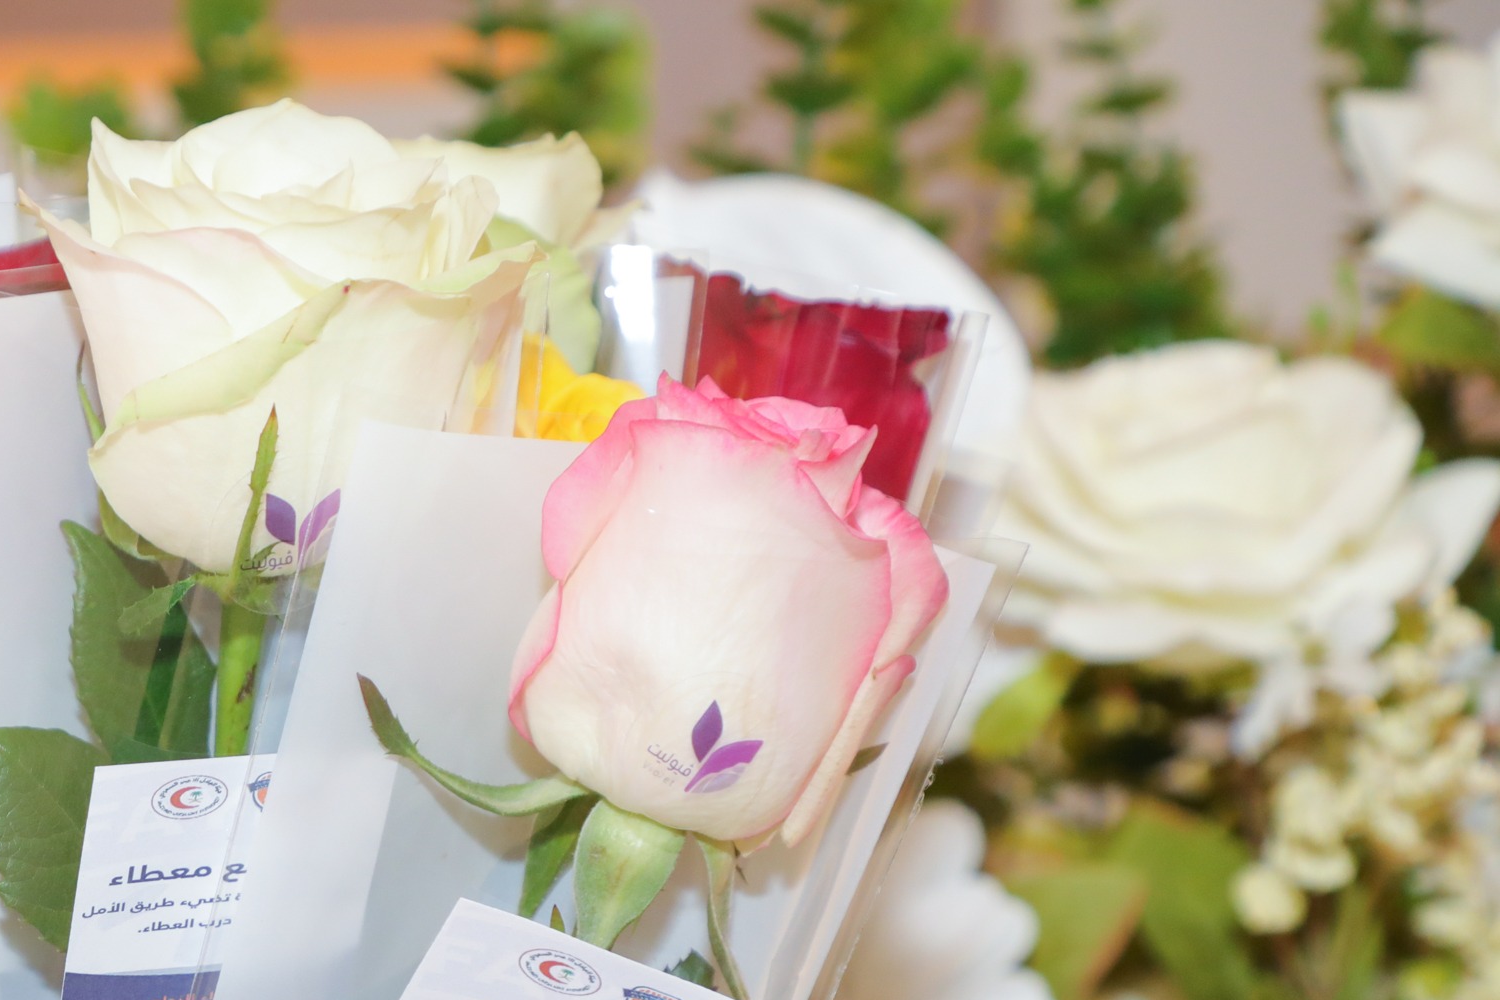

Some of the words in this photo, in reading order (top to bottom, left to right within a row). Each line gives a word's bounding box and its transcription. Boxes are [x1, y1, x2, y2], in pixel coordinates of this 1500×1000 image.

[109, 864, 212, 886] معطاء
[81, 902, 125, 919] الأمل
[130, 898, 174, 914] طريق
